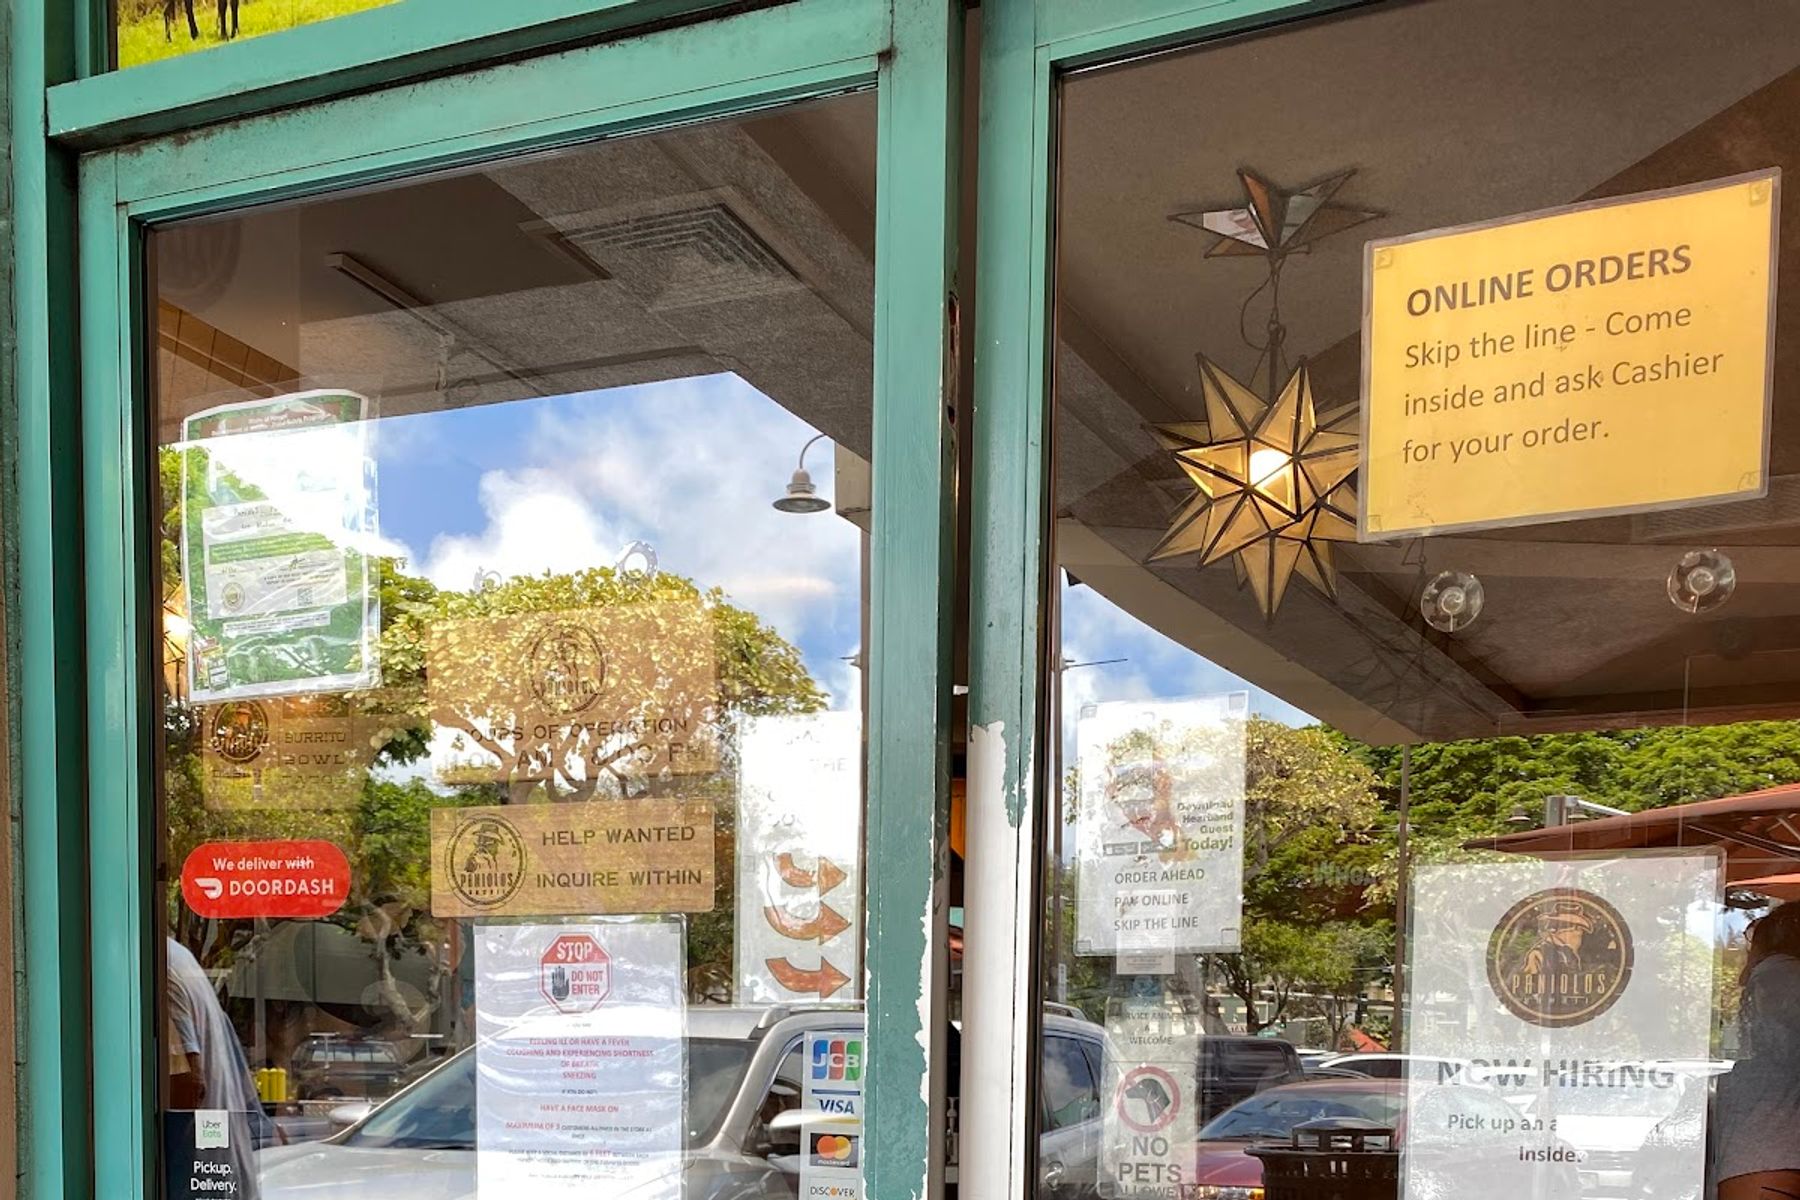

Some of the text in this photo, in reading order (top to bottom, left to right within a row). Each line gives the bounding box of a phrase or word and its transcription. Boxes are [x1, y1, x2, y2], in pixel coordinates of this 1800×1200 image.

[1407, 244, 1692, 317] ONLINE ORDERS
[1405, 340, 1460, 369] Skip
[1469, 332, 1515, 359] the
[1525, 323, 1576, 350] line
[1606, 306, 1692, 337] Come
[1404, 351, 1725, 416] inside and ask Cashier
[1402, 418, 1610, 465] for your order.
[285, 731, 346, 744] BURRITO
[534, 724, 561, 740] OF
[285, 754, 346, 766] BOWL
[542, 826, 696, 847] HELP WANTED
[1200, 824, 1234, 834] Guest
[1183, 835, 1234, 852] Today!
[213, 855, 315, 870] We deliver with
[536, 869, 702, 889] INQUIRE WITHIN
[1115, 868, 1205, 885] ORDER AHEAD
[229, 878, 334, 896] DOORDASH
[1115, 893, 1189, 909] PAY ONLINE
[1114, 916, 1199, 932] SKIP THE LINE
[557, 941, 593, 962] STOP
[571, 969, 604, 984] DO NOT
[1511, 973, 1606, 995] PANIOLOS
[571, 983, 600, 996] ENTER
[1437, 1058, 1676, 1090] NOW HIRING
[819, 1099, 855, 1114] VISA
[202, 1120, 222, 1129] Uber
[1447, 1113, 1485, 1131] Pick
[1491, 1117, 1516, 1134] up
[1520, 1117, 1544, 1132] an
[202, 1130, 222, 1139] Eats
[1131, 1136, 1169, 1157] NO
[193, 1160, 232, 1177] Pickup.
[1118, 1162, 1183, 1184] PETS
[190, 1177, 237, 1194] Delivery.
[810, 1186, 855, 1198] DISCOVER
